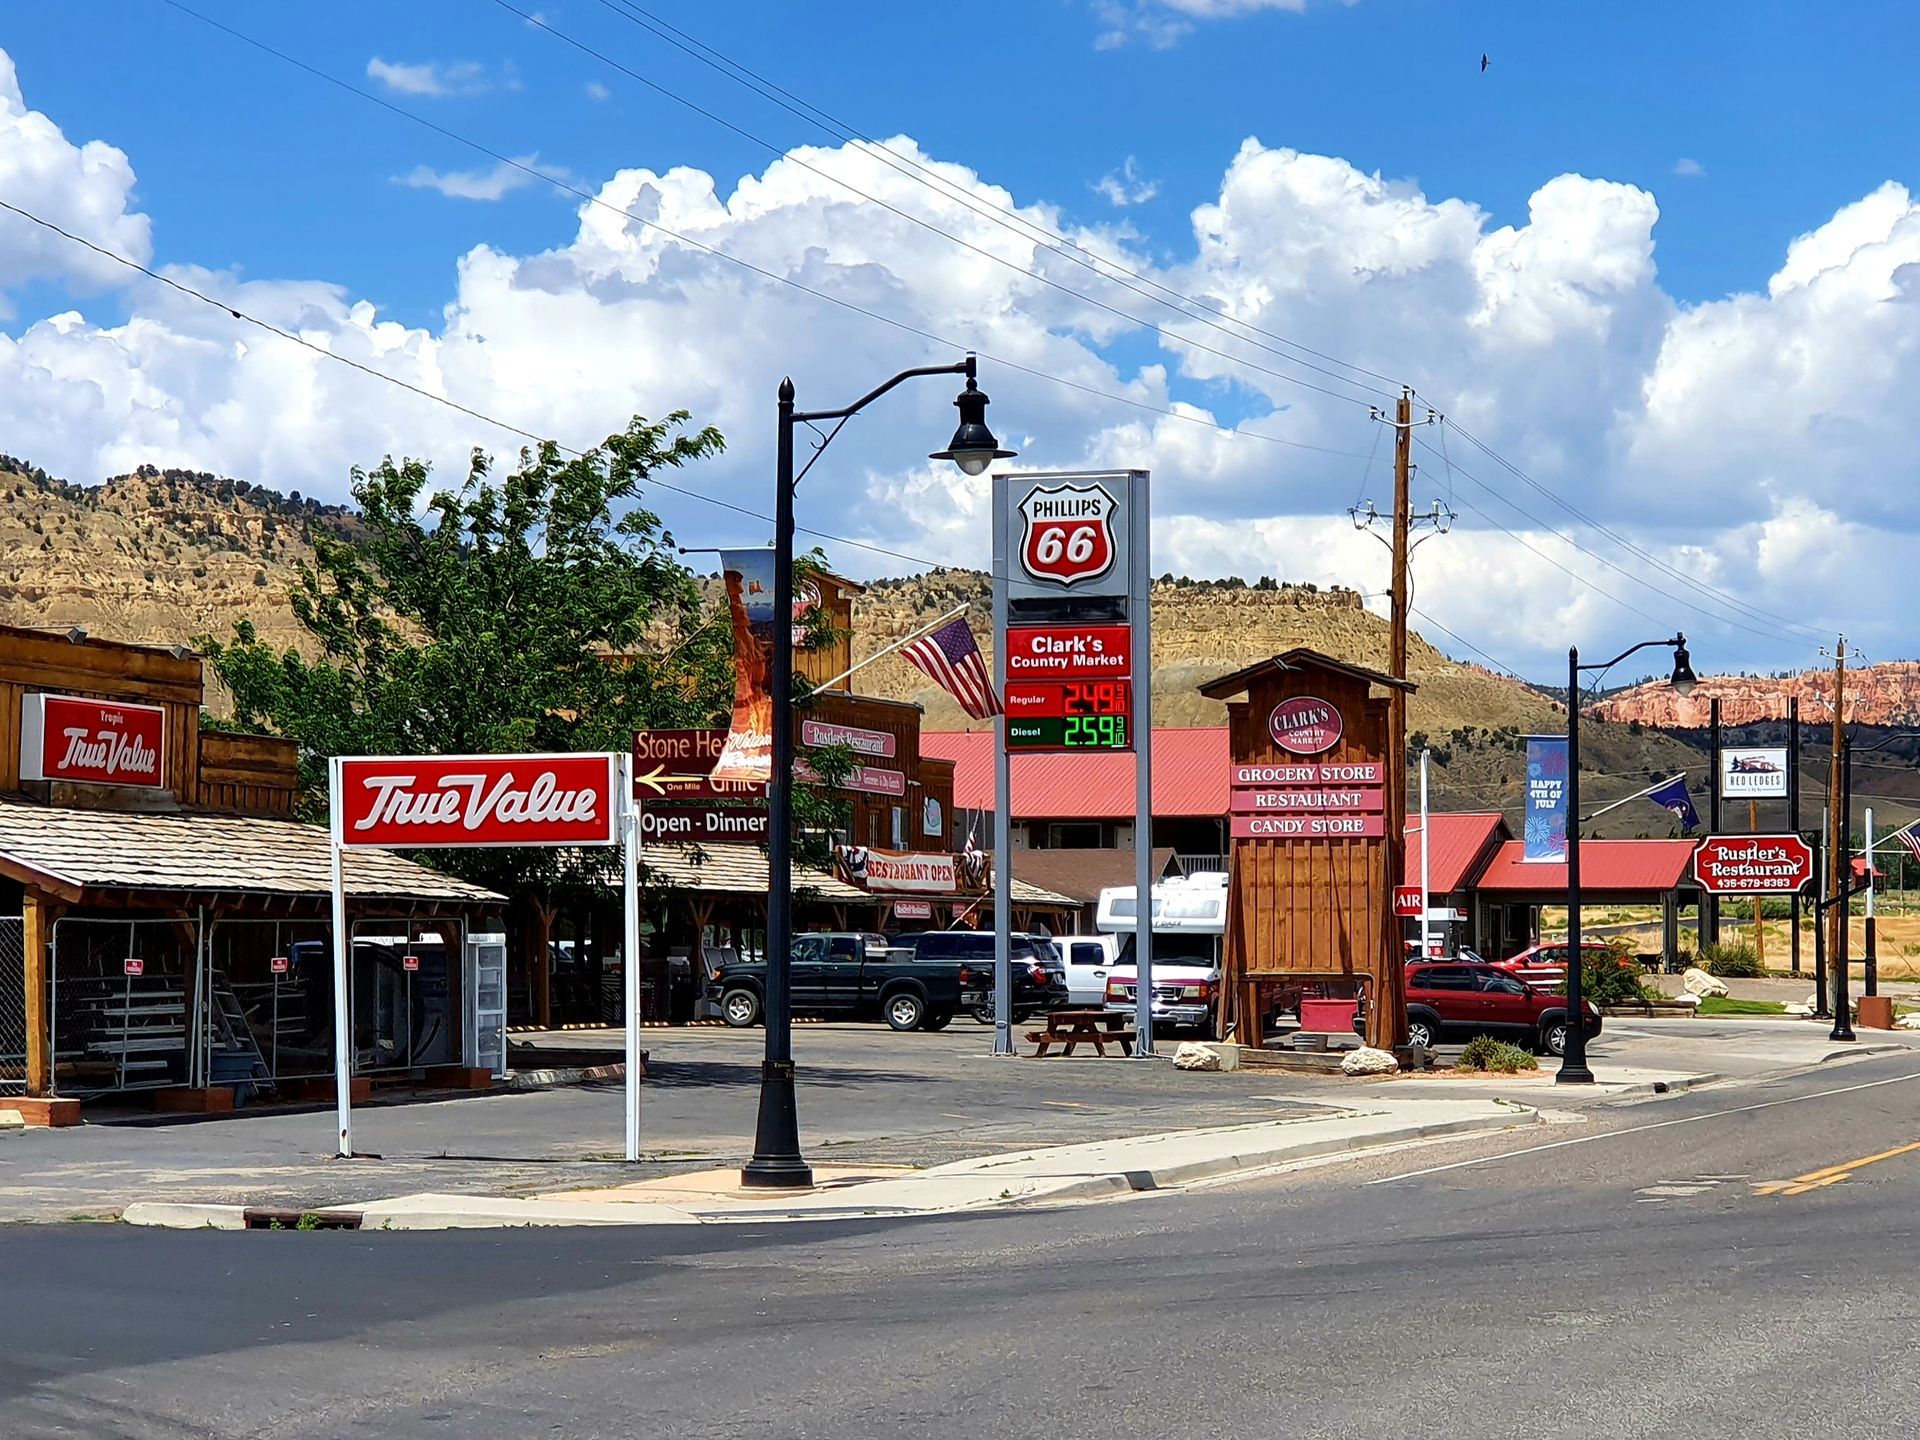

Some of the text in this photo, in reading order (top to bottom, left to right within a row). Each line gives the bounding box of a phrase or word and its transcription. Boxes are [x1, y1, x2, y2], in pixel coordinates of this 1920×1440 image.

[1033, 498, 1101, 518] PHILLIPS
[1036, 526, 1097, 565] 66
[1031, 635, 1104, 653] Clark's
[1011, 654, 1124, 670] Country Market
[1010, 695, 1045, 705] Regular
[1274, 706, 1329, 731] CLARK'S
[1011, 728, 1041, 737] Diesel
[1064, 716, 1114, 745] 2.59
[1288, 730, 1325, 738] COUNTRY
[637, 730, 729, 759] Stone He
[1290, 737, 1324, 745] MARKET
[1238, 766, 1376, 781] GROCERY STORE
[1730, 775, 1781, 786] RED LEDGES
[666, 783, 683, 791] One
[1530, 780, 1562, 789] HAPPY
[1255, 793, 1362, 807] RESTAURANT
[1529, 789, 1562, 799] 4TH OF
[1535, 799, 1557, 809] JULY
[641, 813, 691, 838] Open
[705, 811, 768, 832] Dinner
[1250, 819, 1365, 833] CANDY STORE
[1709, 841, 1787, 860] Rustler's
[868, 860, 953, 882] RESTAURANT OPEN
[1703, 859, 1803, 876] Restaurant
[1396, 893, 1422, 908] AIR
